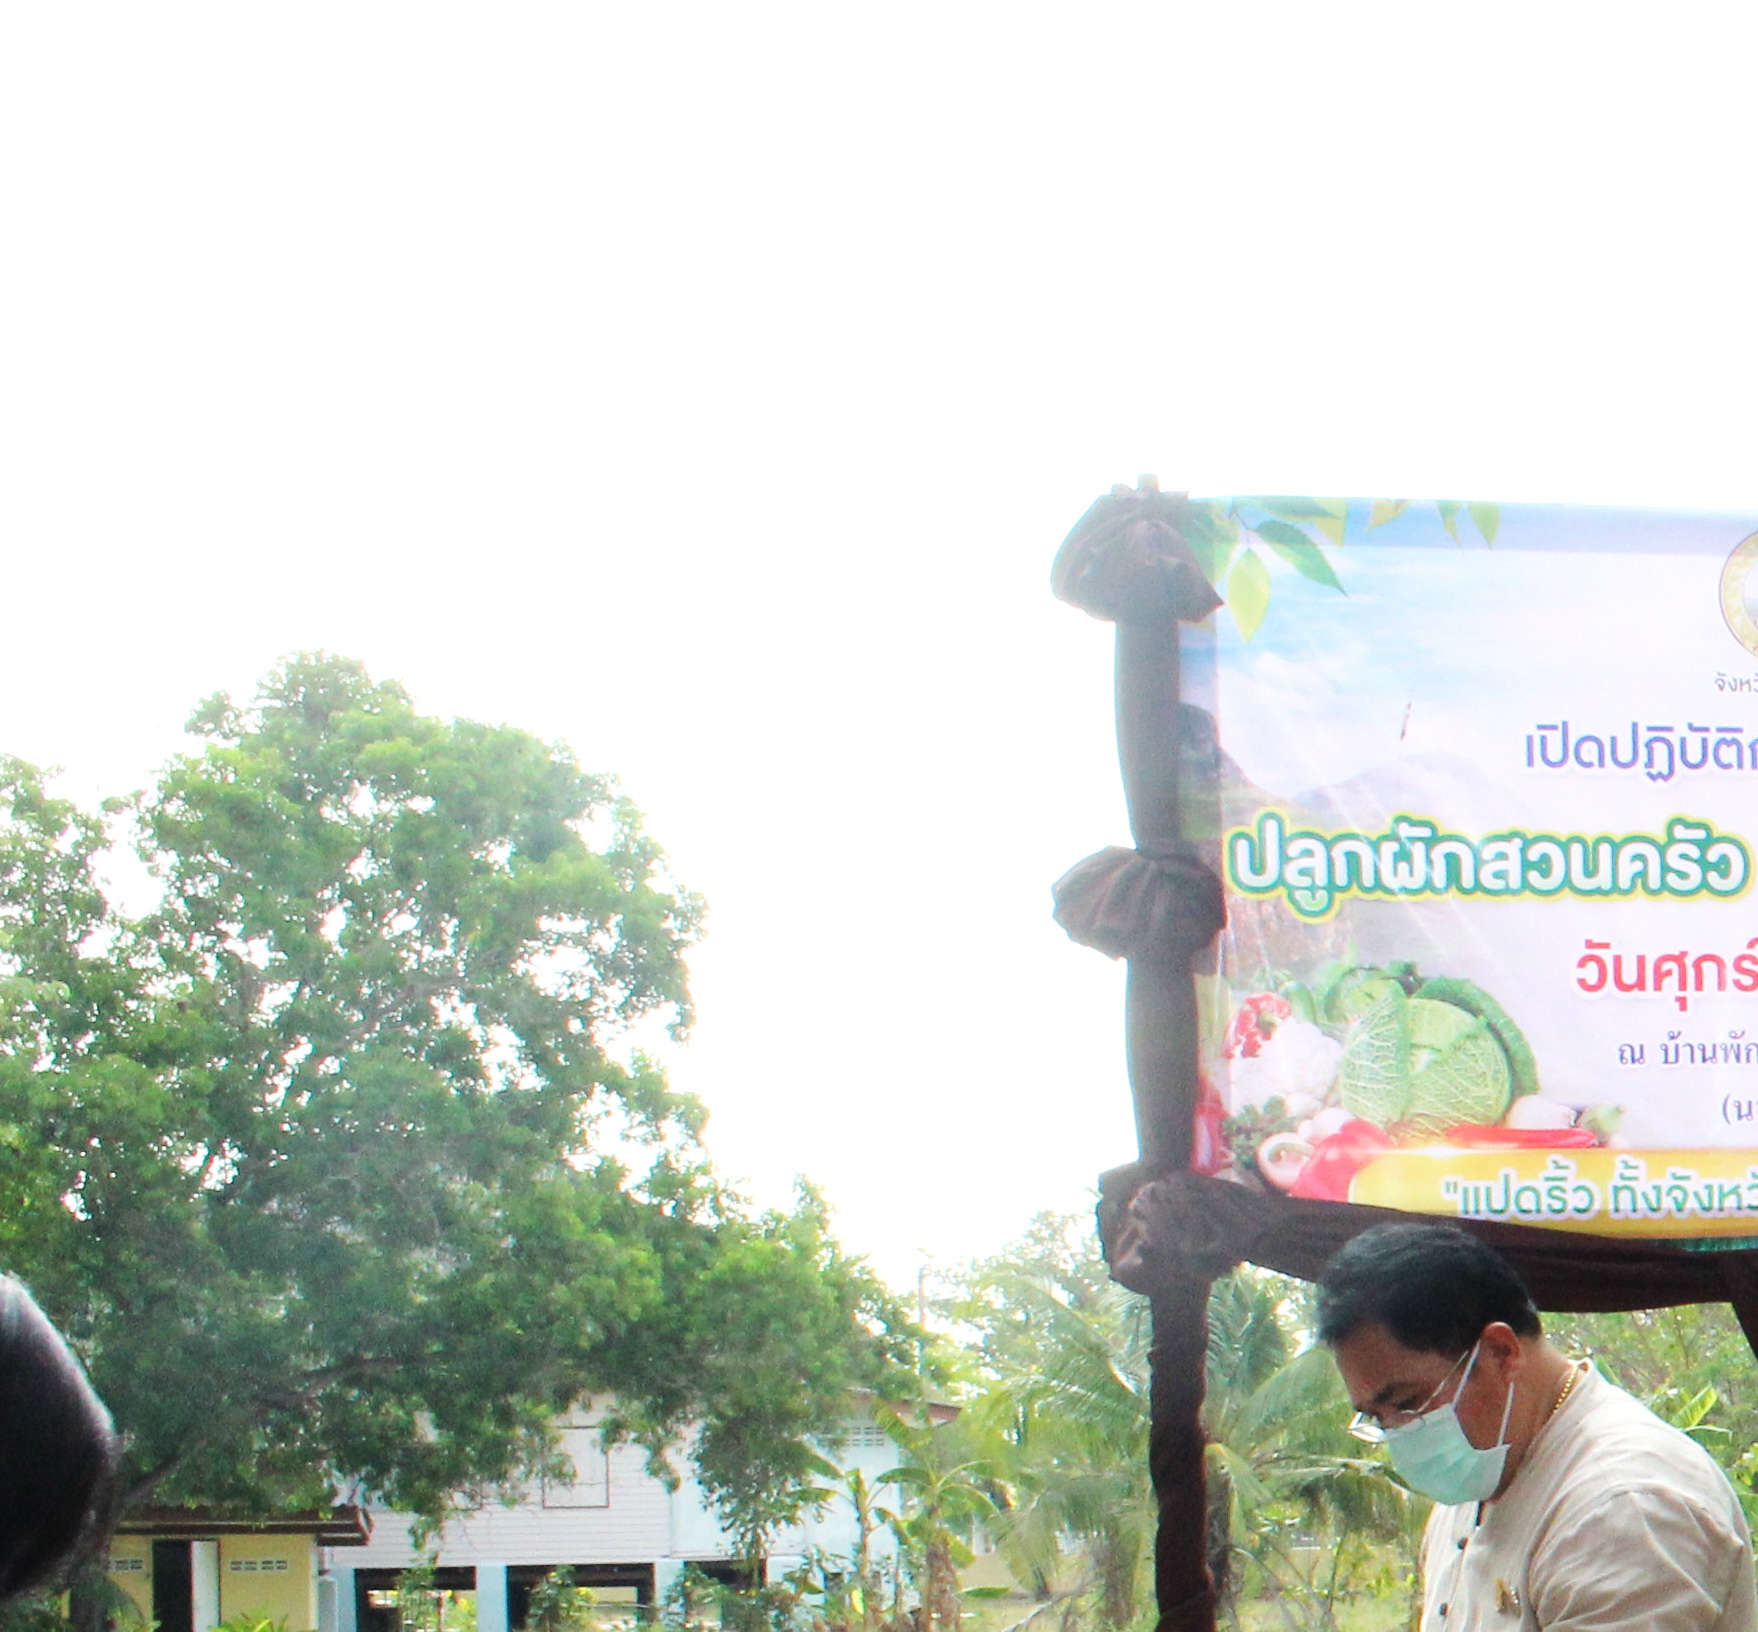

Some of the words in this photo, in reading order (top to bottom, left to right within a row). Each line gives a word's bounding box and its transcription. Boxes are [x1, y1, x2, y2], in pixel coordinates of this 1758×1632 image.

[1229, 813, 1752, 918] ปลูกผักสวนครัว
[1618, 1042, 1646, 1065] ณ
